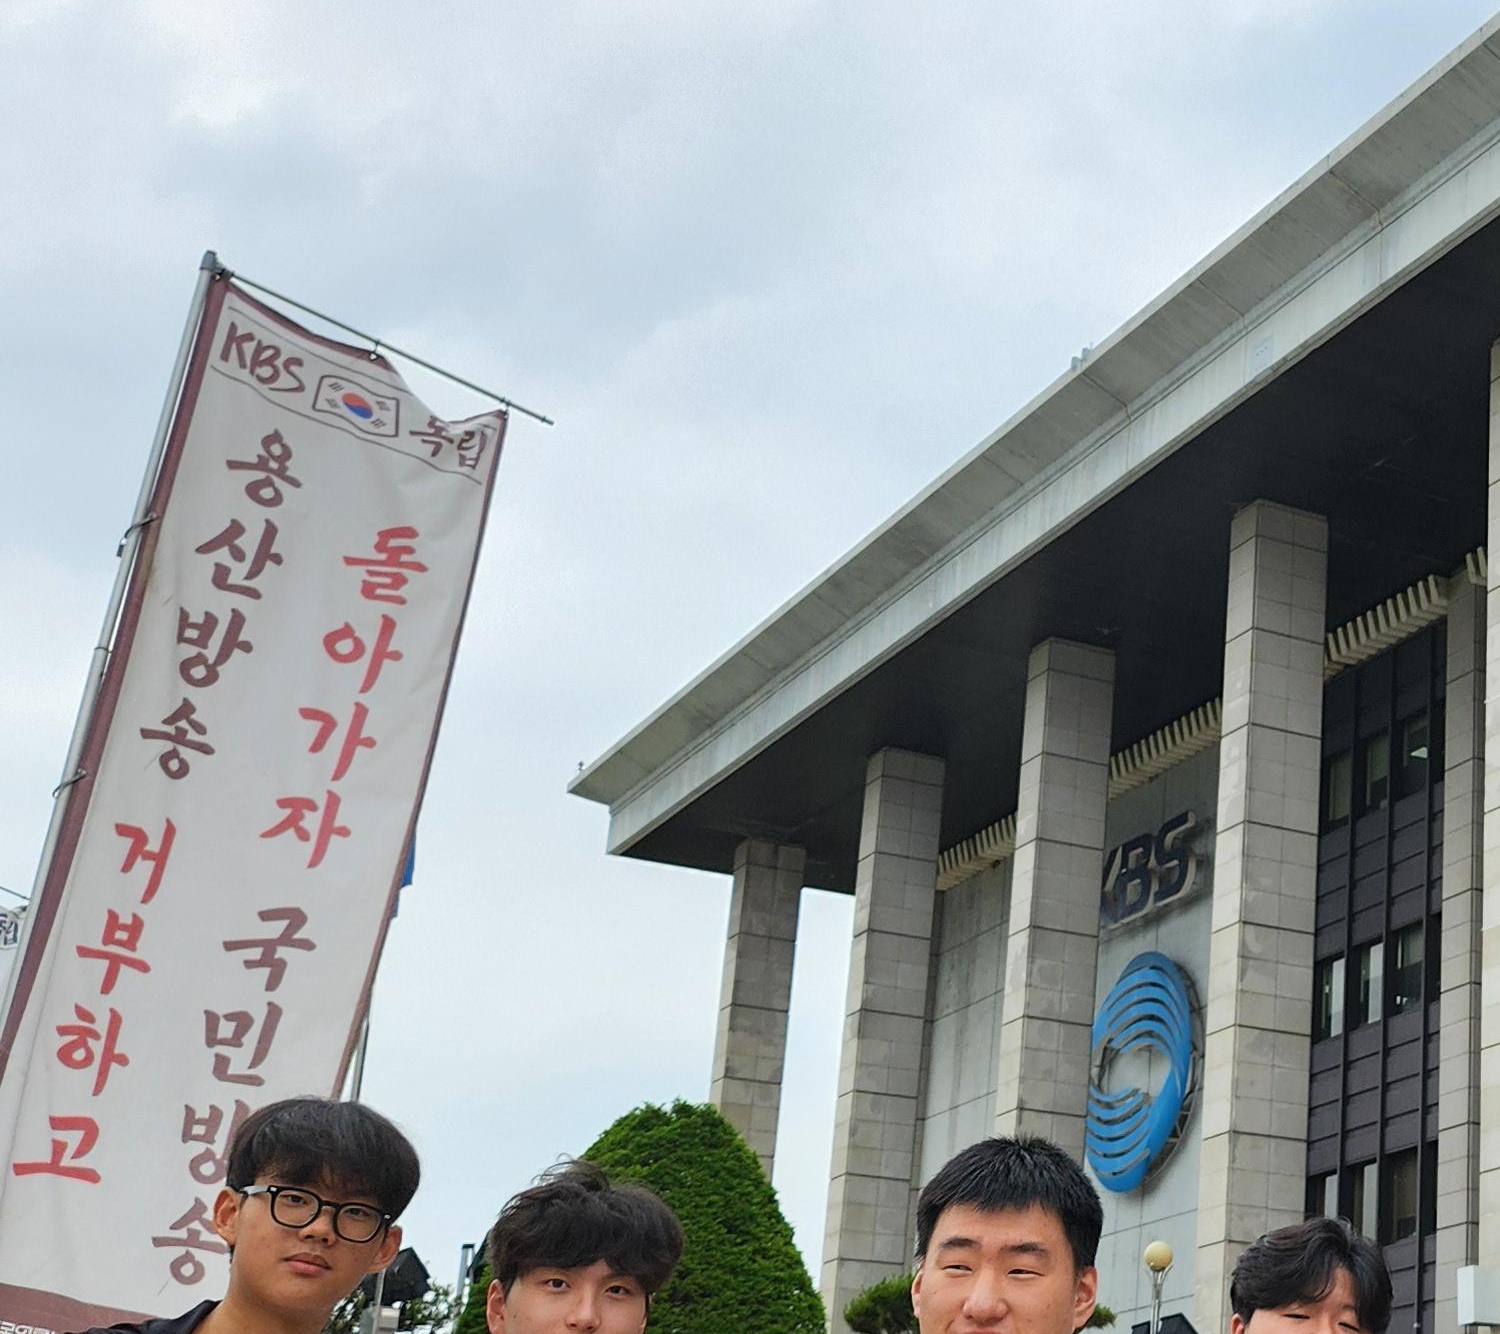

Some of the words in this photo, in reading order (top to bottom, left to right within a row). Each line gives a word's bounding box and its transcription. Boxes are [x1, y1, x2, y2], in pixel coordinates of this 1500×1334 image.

[220, 321, 305, 393] KBS
[140, 428, 303, 780] 용산방송
[259, 525, 430, 870] 돌아가자
[13, 817, 177, 1184] 거부하고
